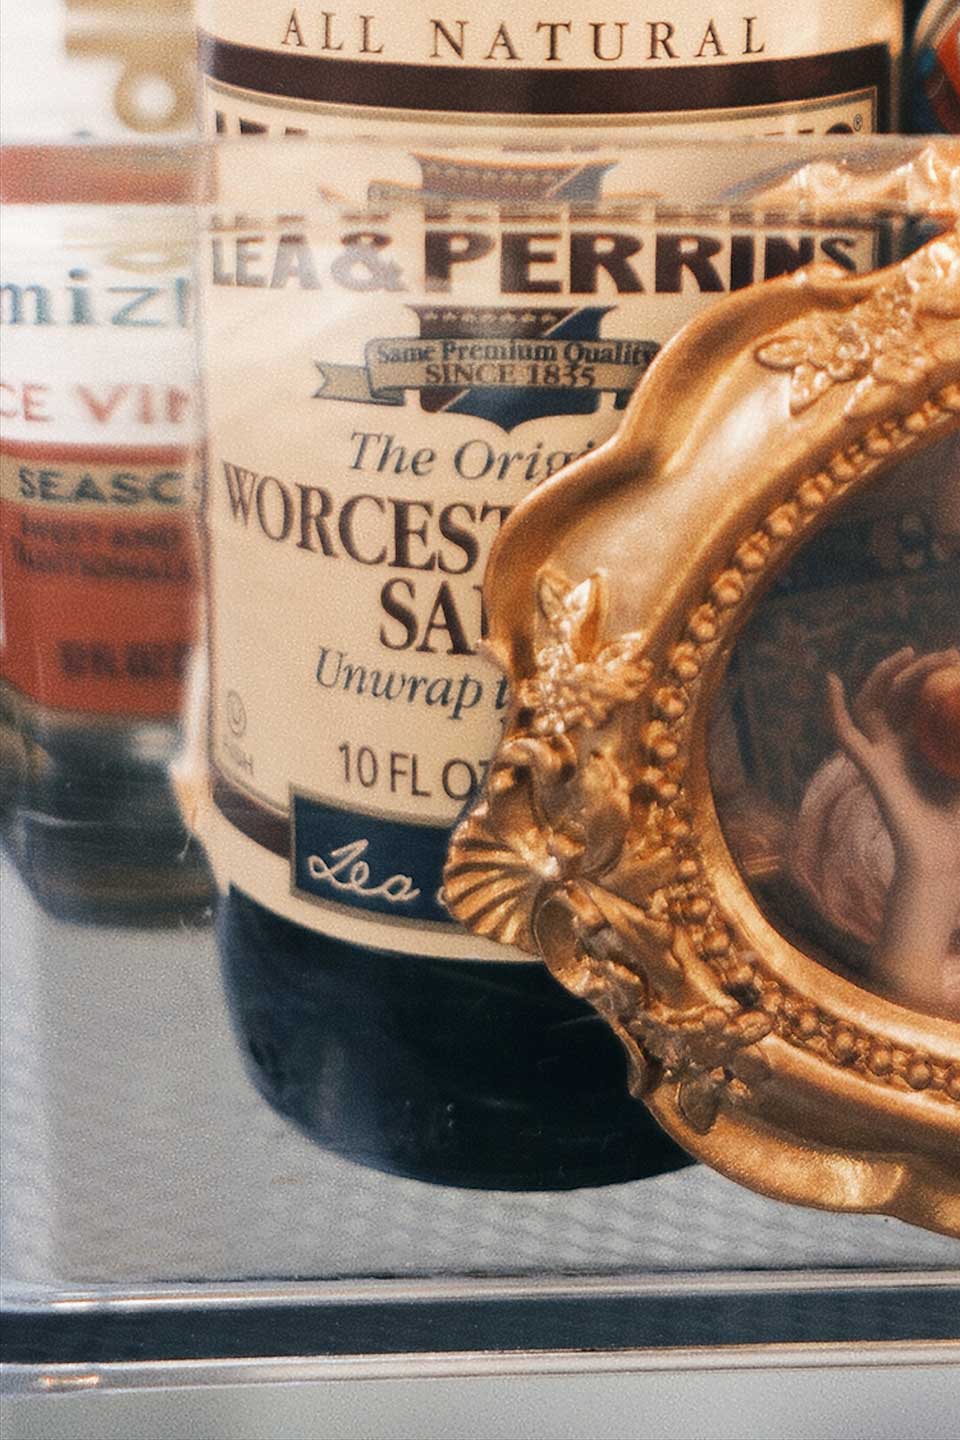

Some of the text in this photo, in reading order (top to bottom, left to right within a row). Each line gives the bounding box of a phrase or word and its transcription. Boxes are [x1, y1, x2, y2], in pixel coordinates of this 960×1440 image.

[281, 7, 768, 62] ALL NATURAL
[377, 342, 436, 363] Same
[441, 340, 558, 362] Premium
[425, 362, 596, 388] SINCE 1835
[350, 431, 437, 478] The
[315, 645, 483, 722] Unwrap
[338, 742, 379, 788] 10
[390, 751, 432, 798] FL
[306, 838, 421, 903] Lea
